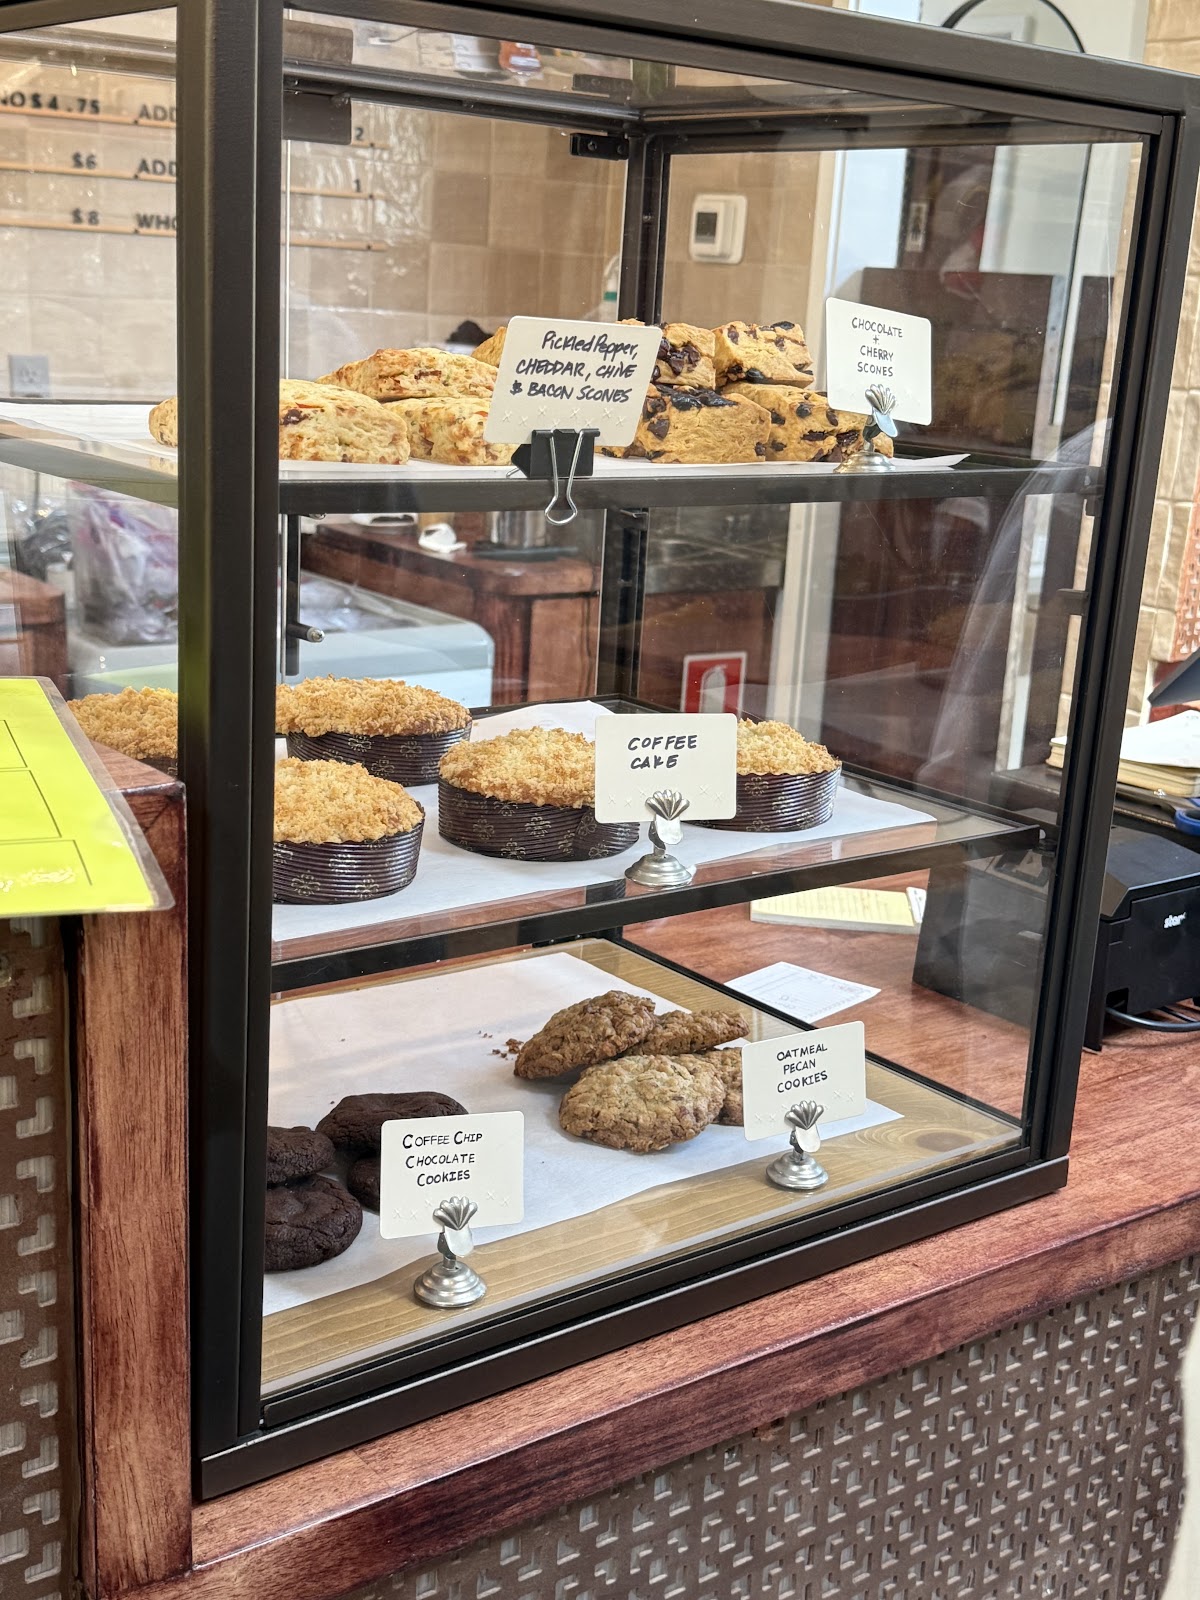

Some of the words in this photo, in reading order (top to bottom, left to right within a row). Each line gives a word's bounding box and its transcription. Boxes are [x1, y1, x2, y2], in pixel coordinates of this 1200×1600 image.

[355, 127, 364, 141] 2
[72, 152, 97, 170] $6
[72, 208, 99, 226] $8
[851, 316, 903, 338] CHOCOLATE
[873, 335, 880, 345] +
[860, 345, 894, 362] CHERRY
[516, 358, 591, 382] CHEDDAR,
[595, 361, 637, 379] CHIVE
[857, 361, 893, 377] SCONES
[527, 382, 574, 399] BACON
[576, 385, 632, 403] SCONES
[627, 734, 698, 751] COFFEE
[630, 754, 679, 769] CAKE
[776, 1043, 828, 1061] OATMEAL
[783, 1058, 816, 1075] PECAN
[777, 1070, 828, 1093] COOKIES
[402, 1134, 450, 1149] COFFEE
[453, 1131, 483, 1145] CHIP
[405, 1153, 475, 1169] CHOCOLATE
[416, 1169, 471, 1187] COOKIES
